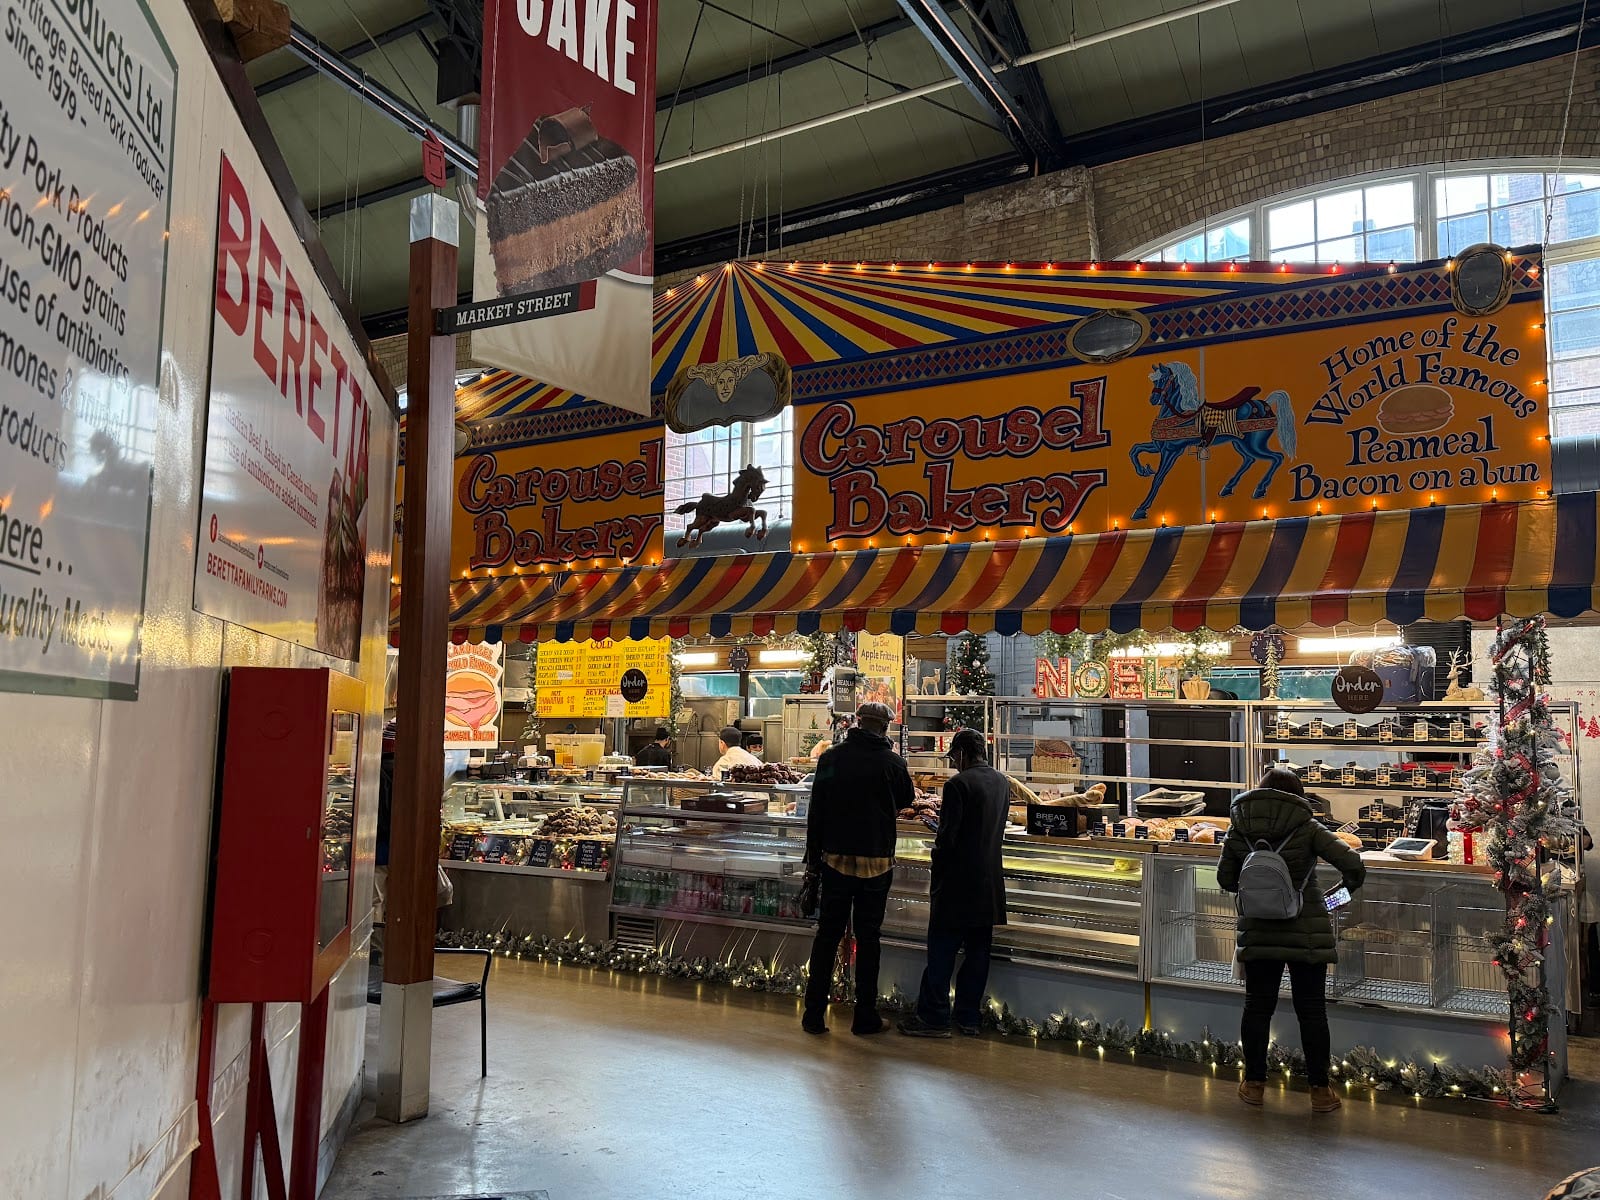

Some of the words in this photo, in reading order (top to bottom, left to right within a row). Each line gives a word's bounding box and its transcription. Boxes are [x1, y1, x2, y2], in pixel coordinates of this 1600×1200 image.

[5, 6, 45, 81] Since
[48, 64, 77, 121] 1979
[69, 47, 104, 115] Breed
[104, 97, 126, 149] Pork
[127, 132, 164, 201] Producer
[137, 64, 164, 154] Ltd.
[0, 102, 21, 170] ty
[23, 134, 65, 214] Pork
[66, 184, 128, 282] Products
[0, 188, 82, 291] non-GMO
[82, 275, 126, 337] grains
[0, 257, 31, 314] use
[35, 292, 57, 332] of
[56, 312, 129, 395] antibiotics
[215, 150, 370, 500] BERETTA
[456, 303, 514, 326] MARKET
[517, 292, 572, 315] STREET
[1320, 329, 1416, 386] Home
[1420, 317, 1457, 349] of
[1462, 323, 1520, 367] the
[1304, 357, 1411, 427] World
[1414, 351, 1538, 419] Famous
[801, 376, 1111, 477] Carousel
[1345, 415, 1500, 467] Peameal
[458, 438, 664, 514] Carousel
[826, 459, 1107, 542] Bakery
[1289, 463, 1404, 502] Bacon
[1409, 469, 1454, 491] on
[470, 505, 664, 570] Bakery
[206, 551, 288, 609] BERETTAFAMILYFARMS.COM
[590, 640, 613, 650] COLD
[861, 648, 879, 661] Apple
[1036, 657, 1178, 699] NOEL
[585, 688, 622, 696] BEVERAGE
[622, 675, 647, 688] Order
[1335, 675, 1381, 693] Order
[1035, 812, 1067, 822] BREAD
